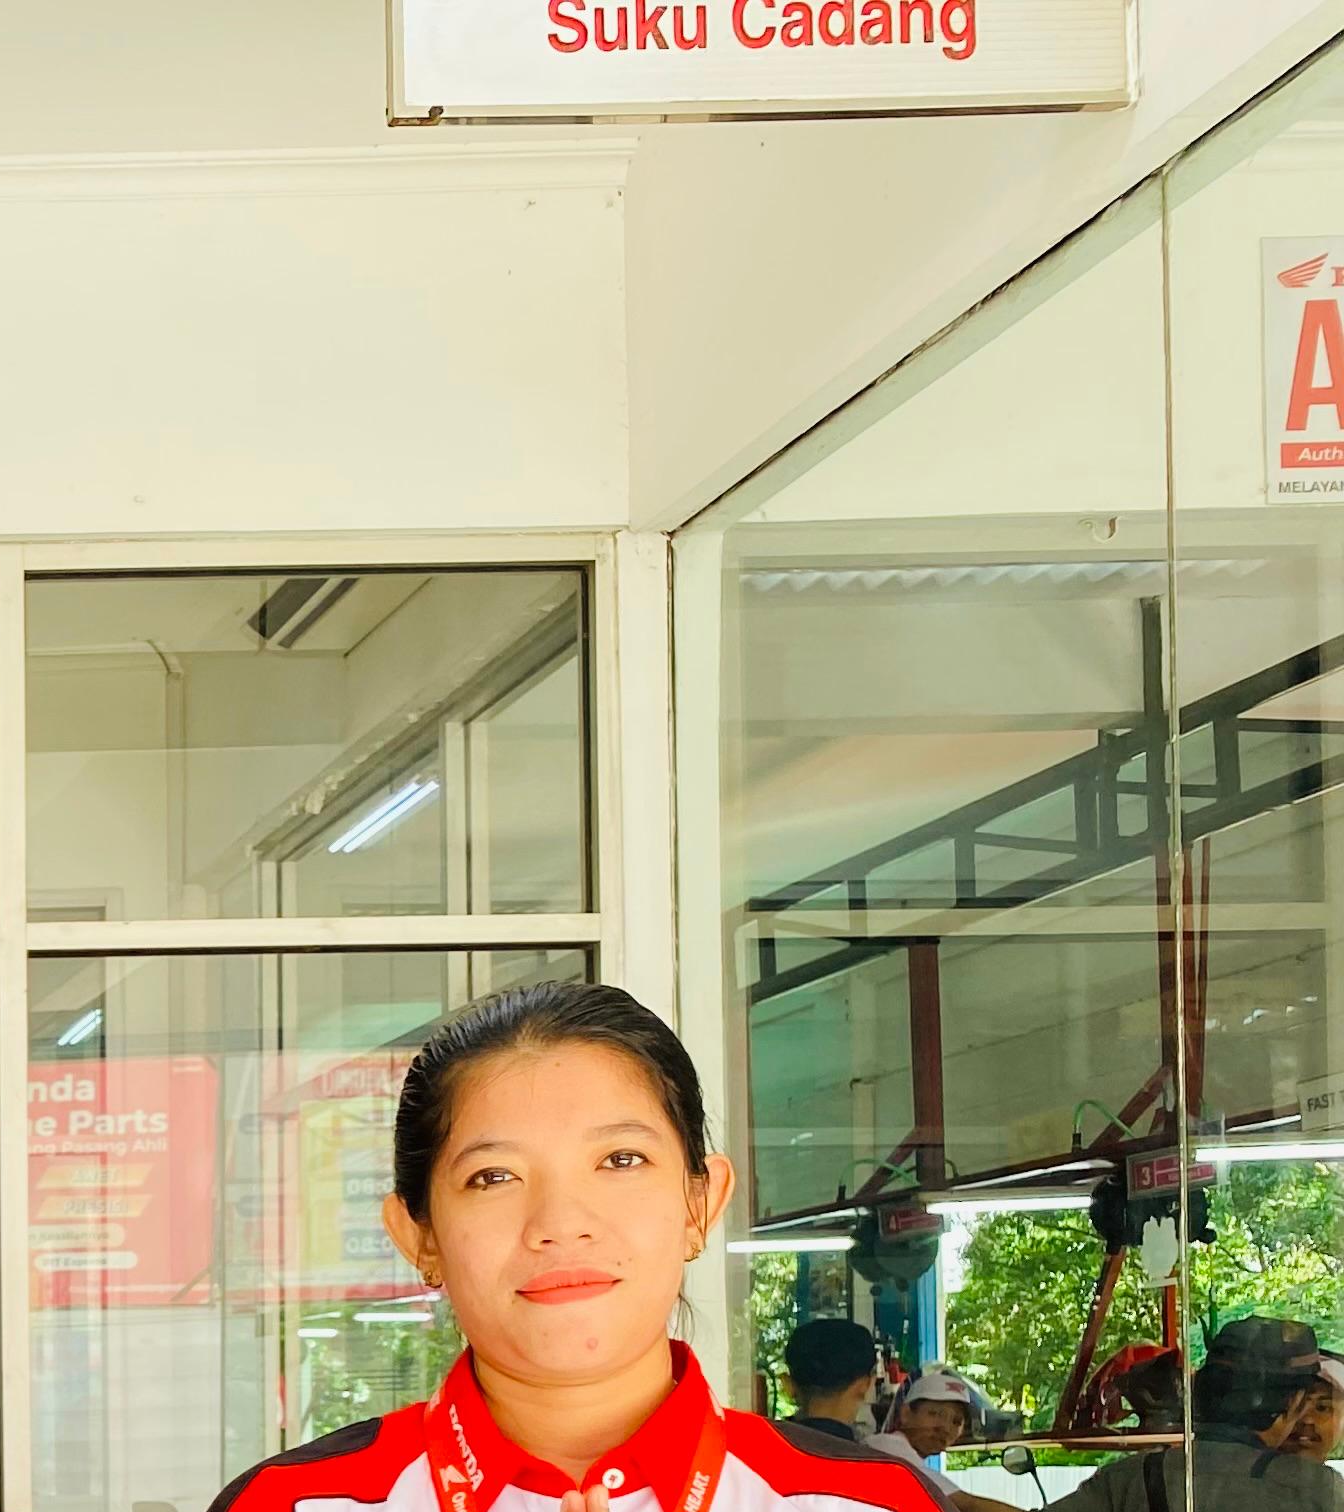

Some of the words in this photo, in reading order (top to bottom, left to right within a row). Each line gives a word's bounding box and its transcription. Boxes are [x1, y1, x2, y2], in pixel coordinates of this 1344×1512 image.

[548, 0, 708, 53] Suku
[732, 0, 977, 60] Cadang
[69, 1108, 169, 1135] Parts
